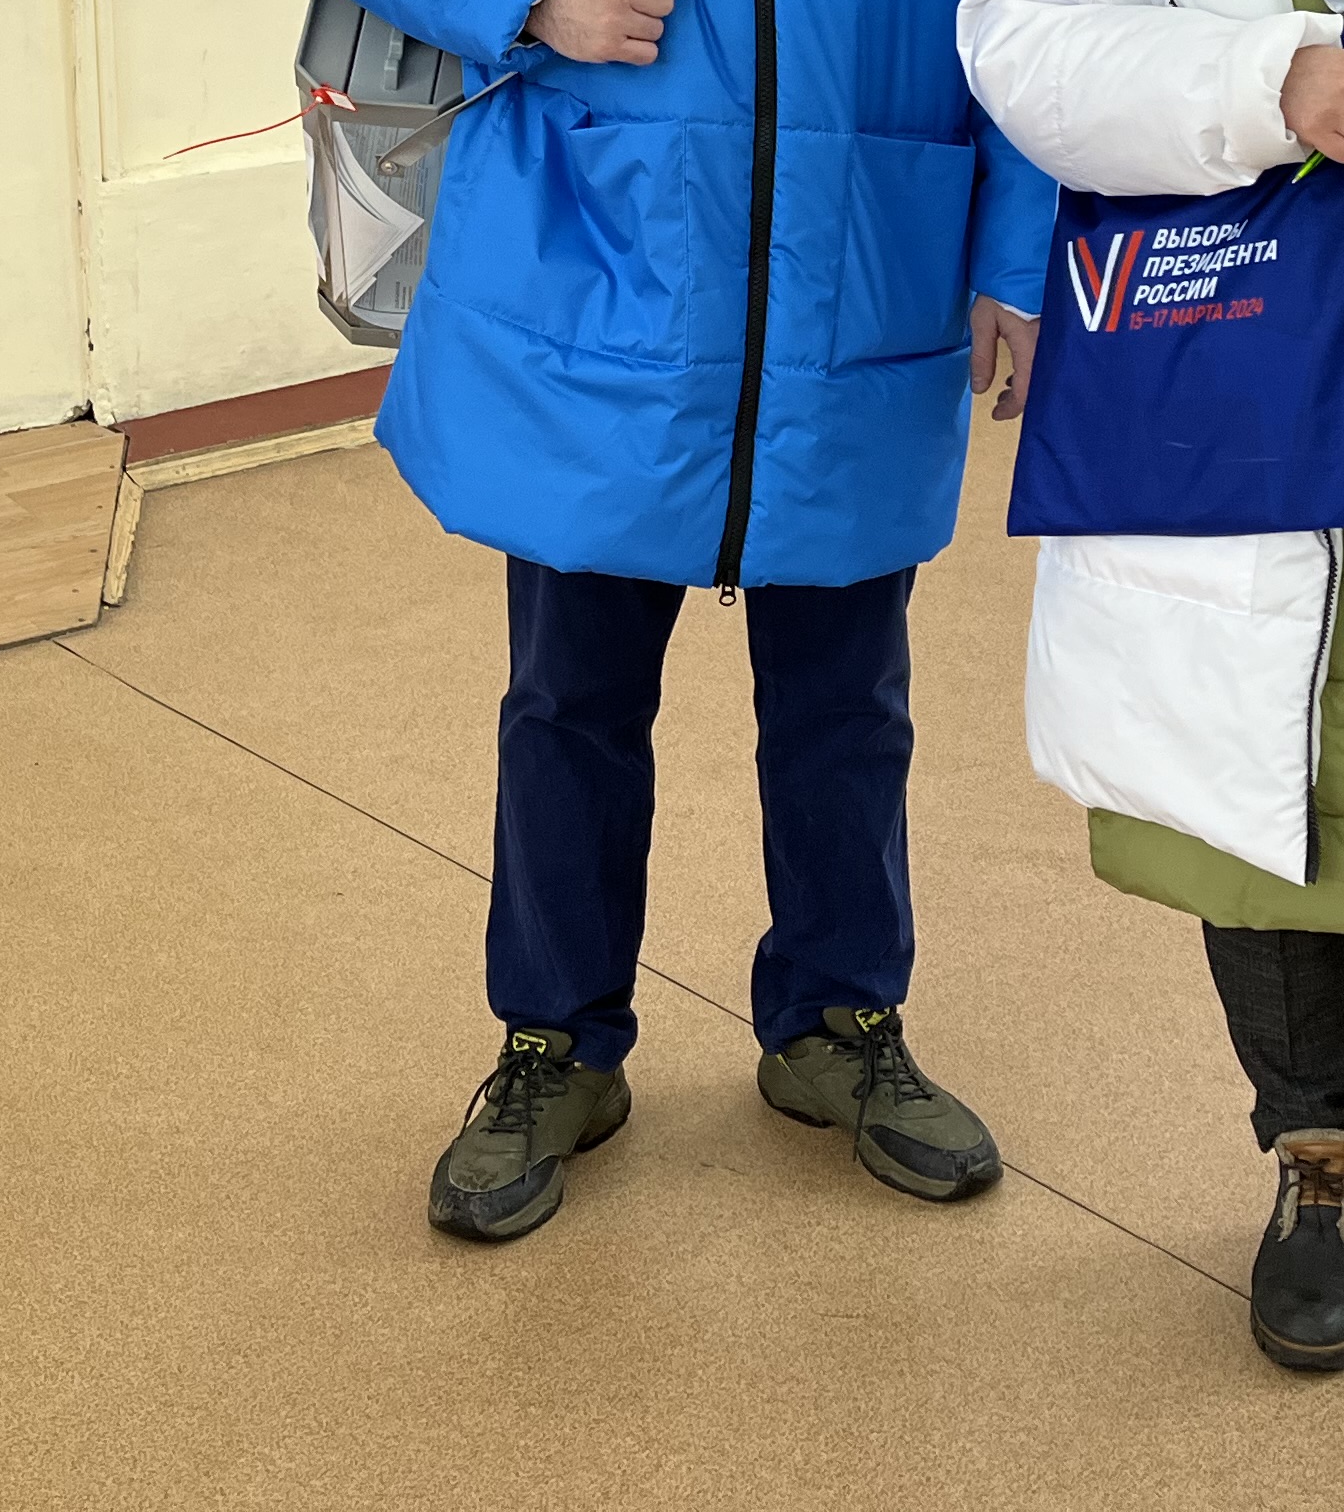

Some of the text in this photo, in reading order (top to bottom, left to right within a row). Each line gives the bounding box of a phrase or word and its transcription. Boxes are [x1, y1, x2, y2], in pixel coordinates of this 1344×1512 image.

[1151, 219, 1249, 250] ВЫБОРЫ
[1142, 239, 1279, 278] ПРЕЗИДЕНТА
[1133, 276, 1219, 306] РОССИИ
[1169, 302, 1223, 327] МАРТА
[1225, 297, 1265, 320] 2024
